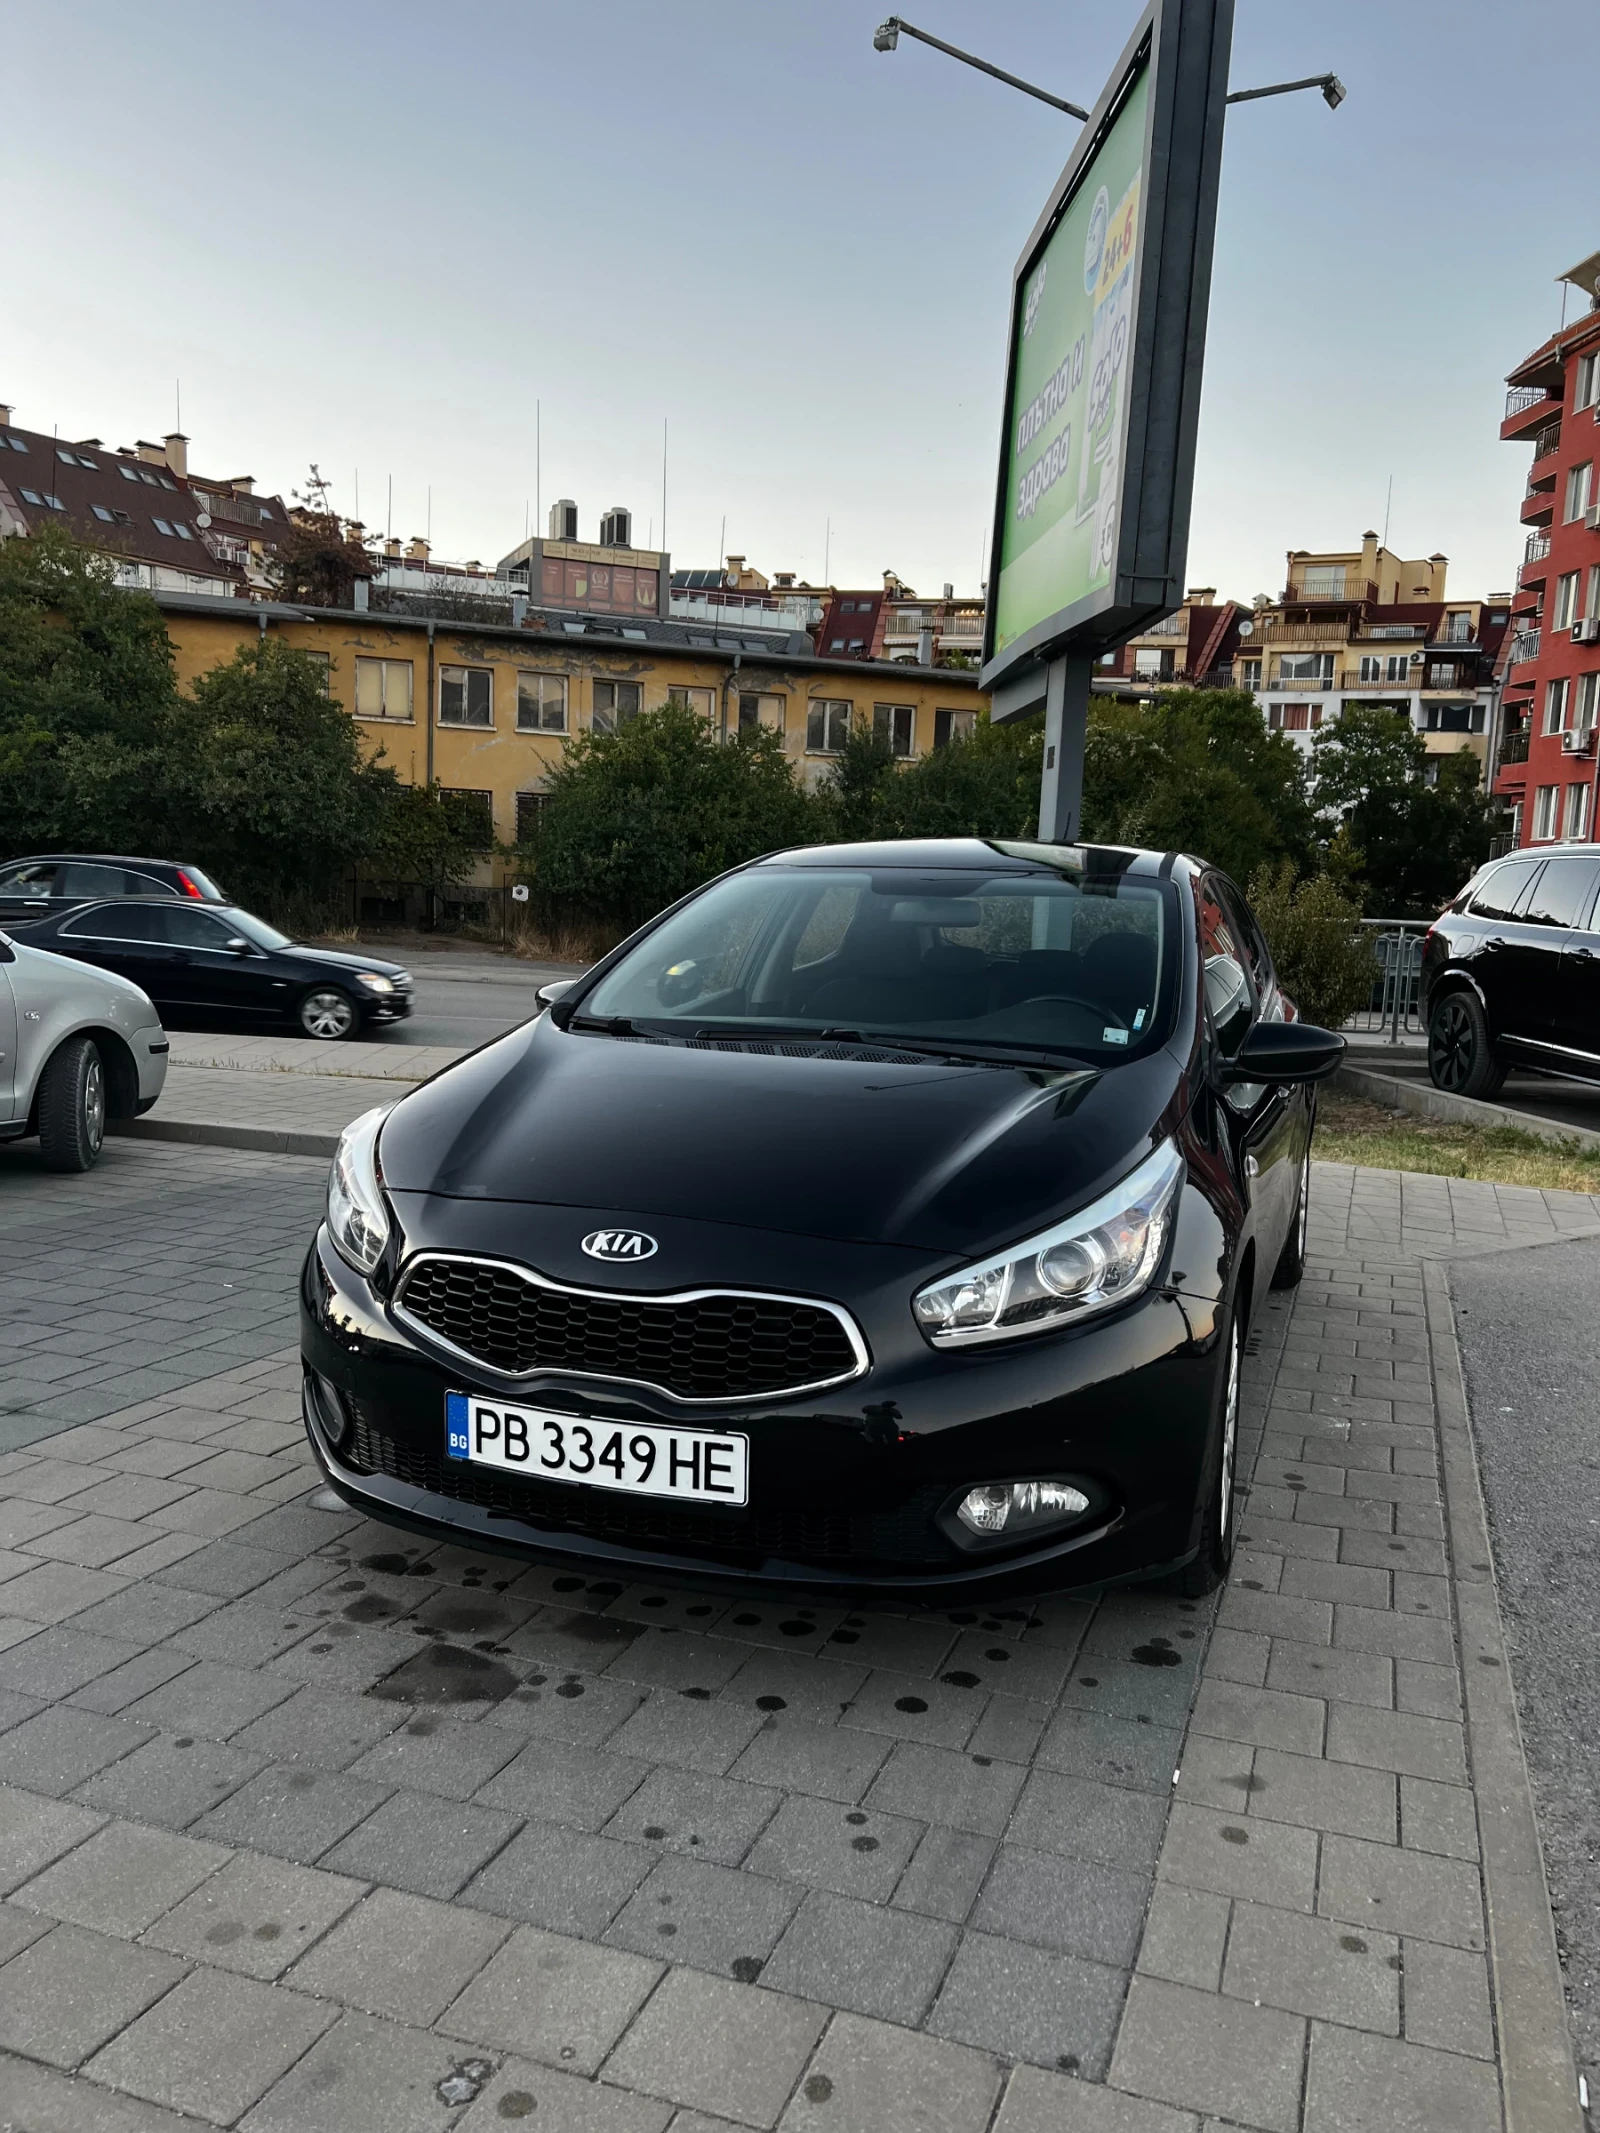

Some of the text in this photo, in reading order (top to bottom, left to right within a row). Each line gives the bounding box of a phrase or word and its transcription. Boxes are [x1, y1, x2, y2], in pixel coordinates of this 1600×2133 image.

[1017, 355, 1069, 457] плътна
[1071, 332, 1085, 393] и
[1088, 314, 1126, 433] Solo
[1017, 422, 1071, 521] здрава
[591, 1232, 642, 1256] KIA
[449, 1431, 468, 1450] BG
[475, 1406, 735, 1495] PB 3349 HE
